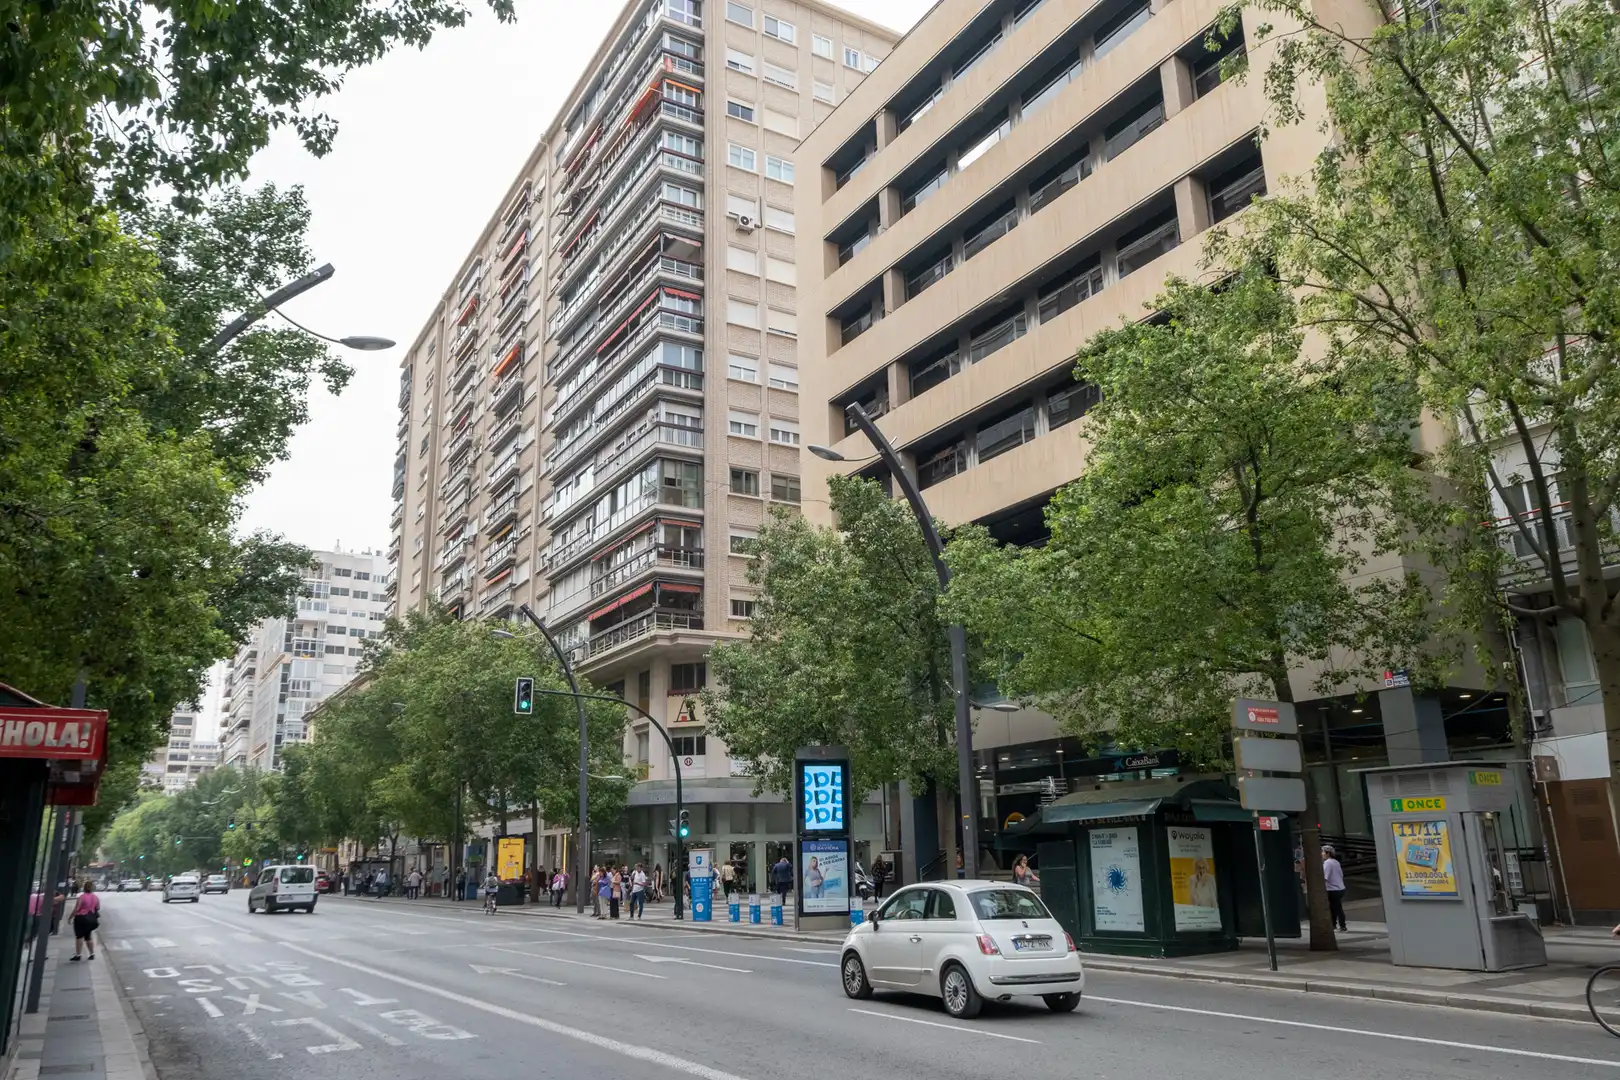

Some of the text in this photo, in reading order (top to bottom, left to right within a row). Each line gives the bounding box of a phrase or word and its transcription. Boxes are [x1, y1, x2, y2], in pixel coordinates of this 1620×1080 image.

[1126, 756, 1160, 767] CaixaBank
[1479, 773, 1500, 784] ONCE
[1407, 799, 1442, 810] ONCE
[1398, 822, 1441, 837] 11/11
[177, 973, 325, 993] BUS
[194, 987, 400, 1018] TAXI
